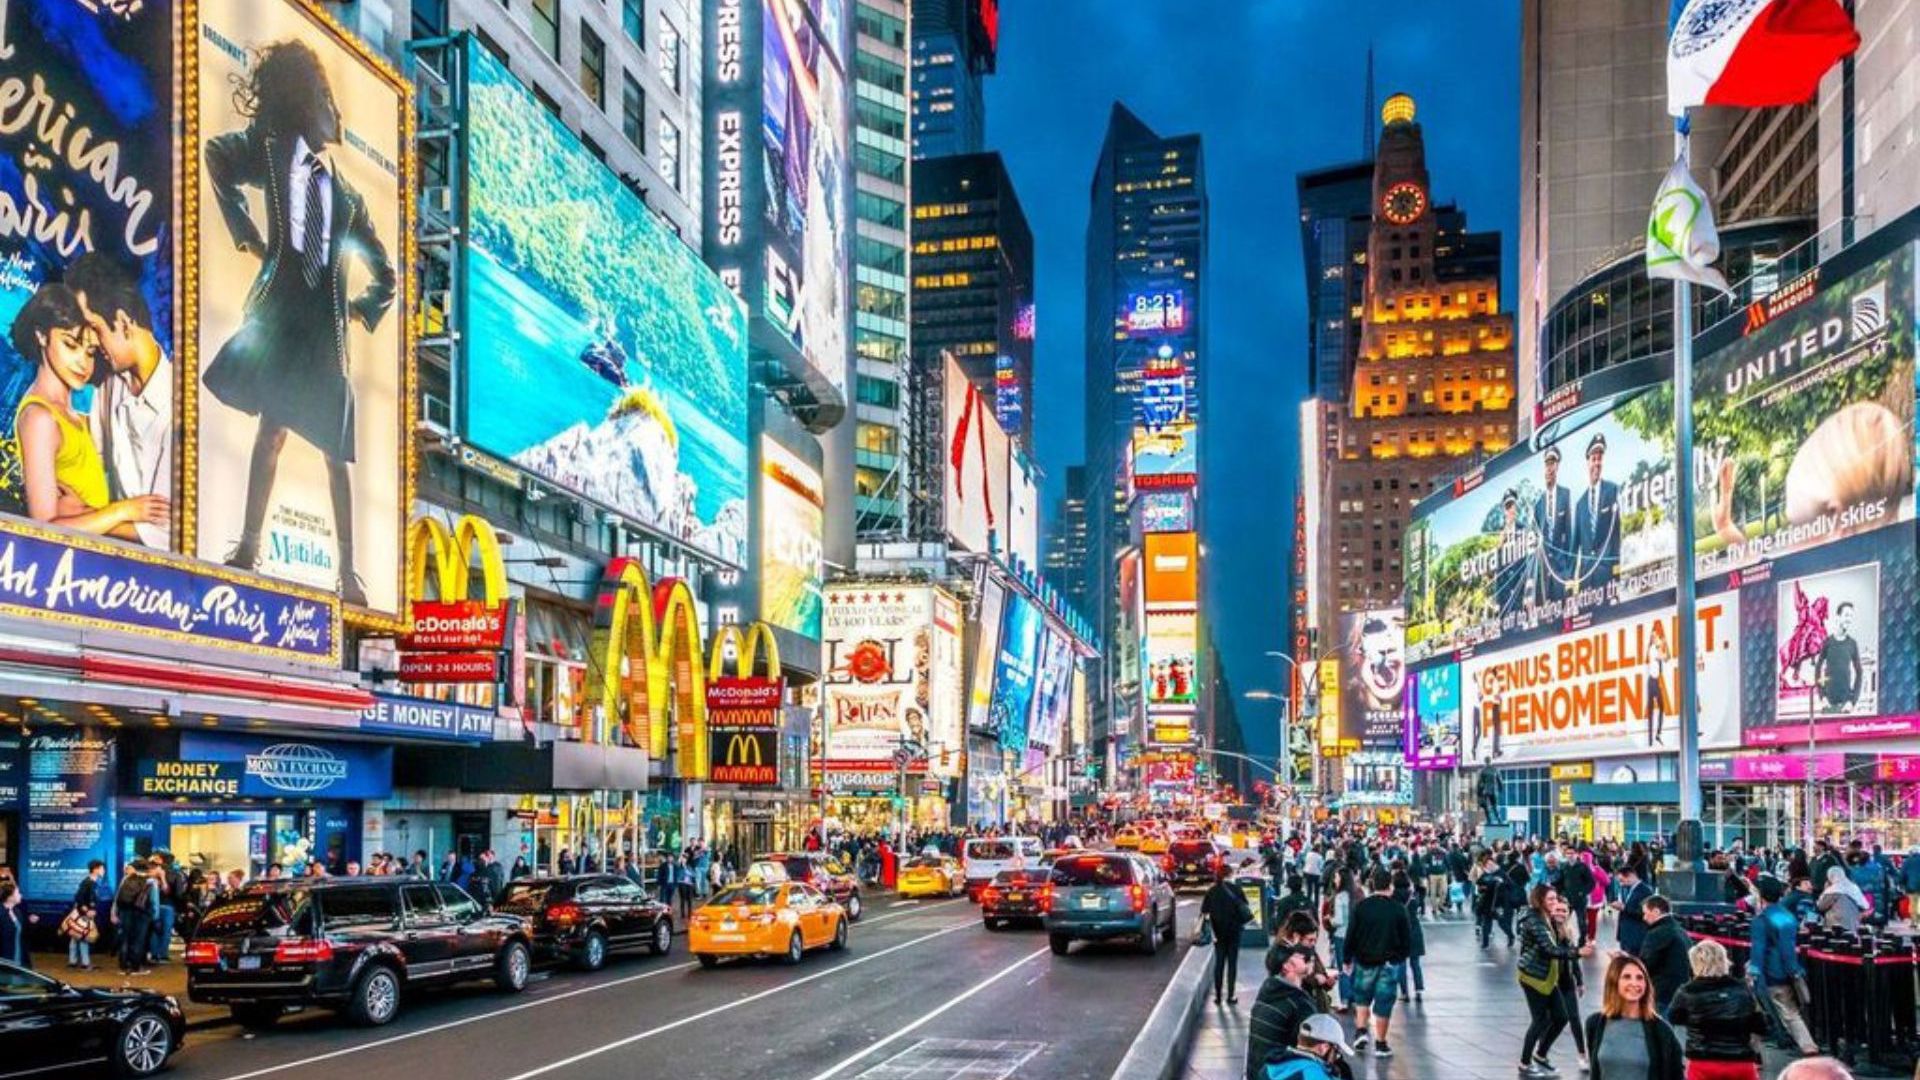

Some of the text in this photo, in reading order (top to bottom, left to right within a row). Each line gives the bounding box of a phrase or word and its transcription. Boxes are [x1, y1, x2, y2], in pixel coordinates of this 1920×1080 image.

[718, 0, 741, 82] RESS
[719, 111, 741, 245] EXPRESS
[1769, 267, 1820, 305] MARRIOTT
[1769, 285, 1814, 318] MARQUIS
[1726, 317, 1844, 394] UNITED
[1136, 475, 1195, 487] TOSHIBA
[1774, 513, 1837, 550] friendly
[269, 530, 332, 570] Matilda
[45, 547, 193, 633] American
[202, 585, 270, 644] Paris
[411, 616, 500, 633] cDonald's
[414, 634, 482, 644] Restaurant
[402, 662, 492, 672] OPEN 24 HOURS
[708, 687, 778, 698] McDonald's
[394, 705, 453, 729] MONEY
[461, 714, 493, 733] ATM
[156, 762, 220, 777] MONEY
[247, 758, 347, 776] MONEY EXCHANGE
[143, 778, 238, 794] EXCHANGE
[826, 773, 897, 786] LUGGAGE
